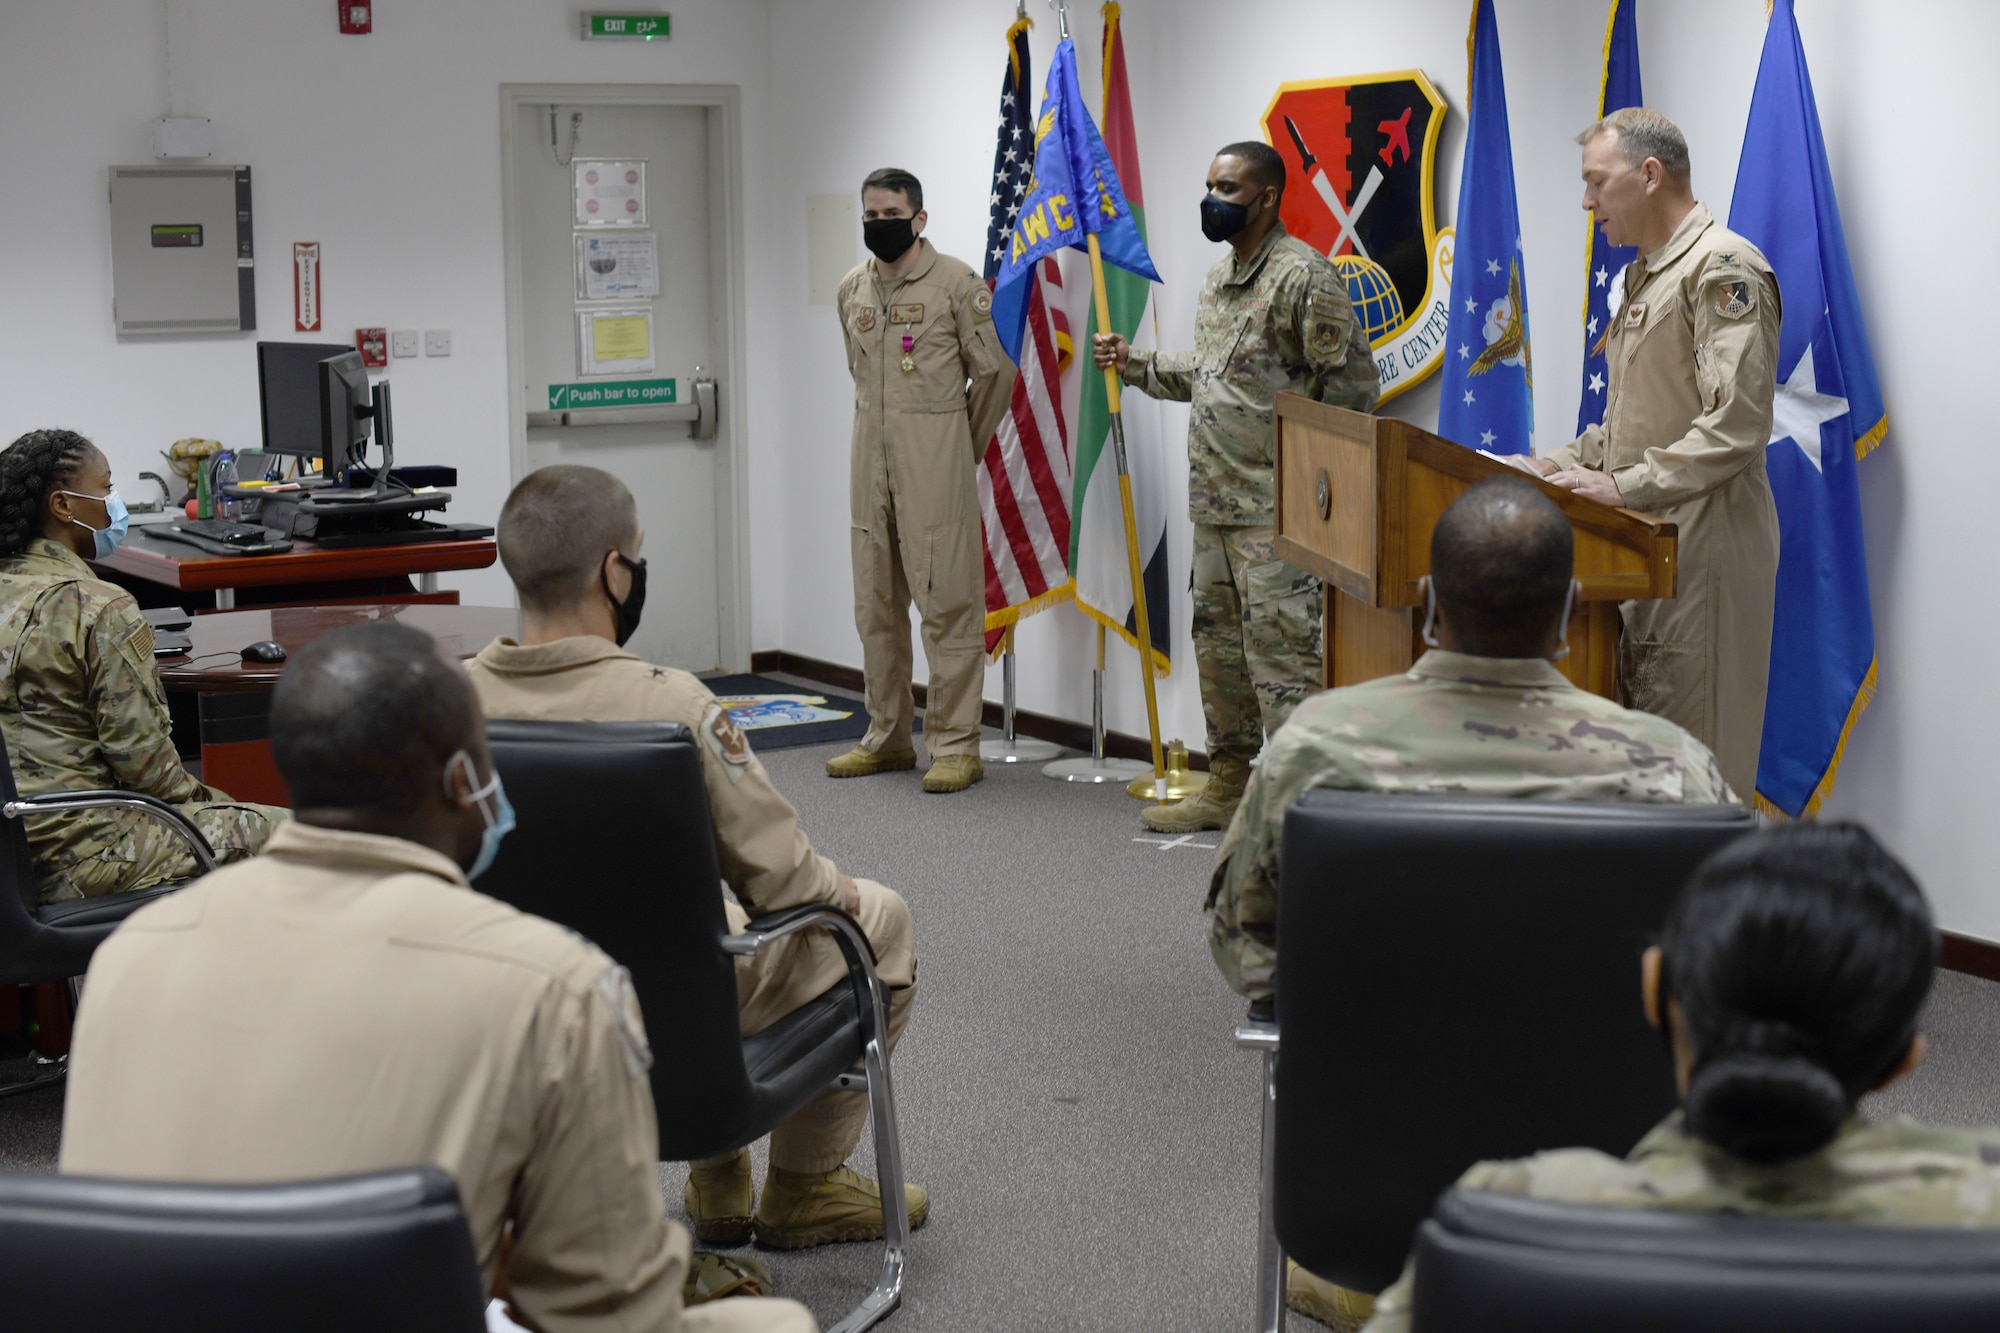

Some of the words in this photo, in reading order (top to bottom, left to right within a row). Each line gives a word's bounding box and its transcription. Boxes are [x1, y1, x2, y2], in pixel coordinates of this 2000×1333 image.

[604, 19, 626, 32] EXIT
[636, 18, 657, 34] خروج
[1011, 194, 1074, 266] AWC
[297, 249, 316, 258] FIRE
[1402, 300, 1449, 369] CENTER
[570, 389, 601, 401] Push
[604, 387, 624, 400] bar
[627, 387, 639, 398] to
[642, 387, 671, 399] open
